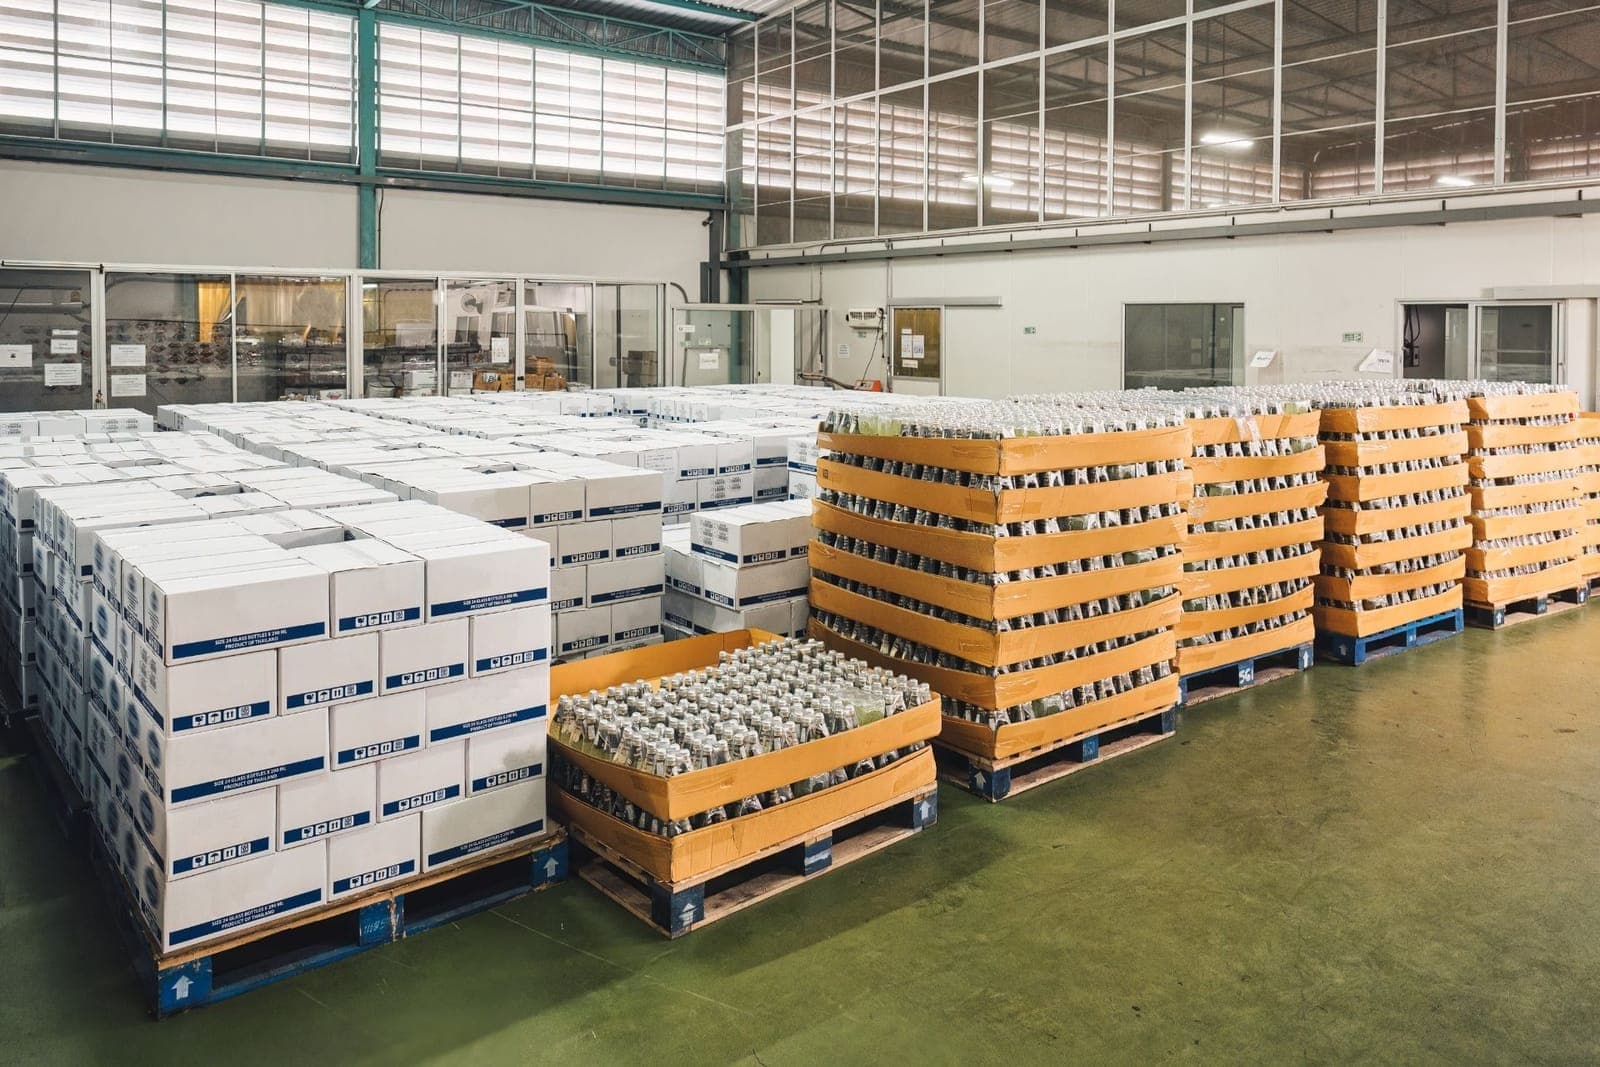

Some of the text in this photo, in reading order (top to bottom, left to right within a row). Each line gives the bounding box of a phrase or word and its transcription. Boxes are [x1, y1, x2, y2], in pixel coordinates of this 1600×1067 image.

[225, 641, 247, 649] PRODUCT
[255, 636, 278, 644] THAILAND
[255, 774, 277, 782] THAILAND
